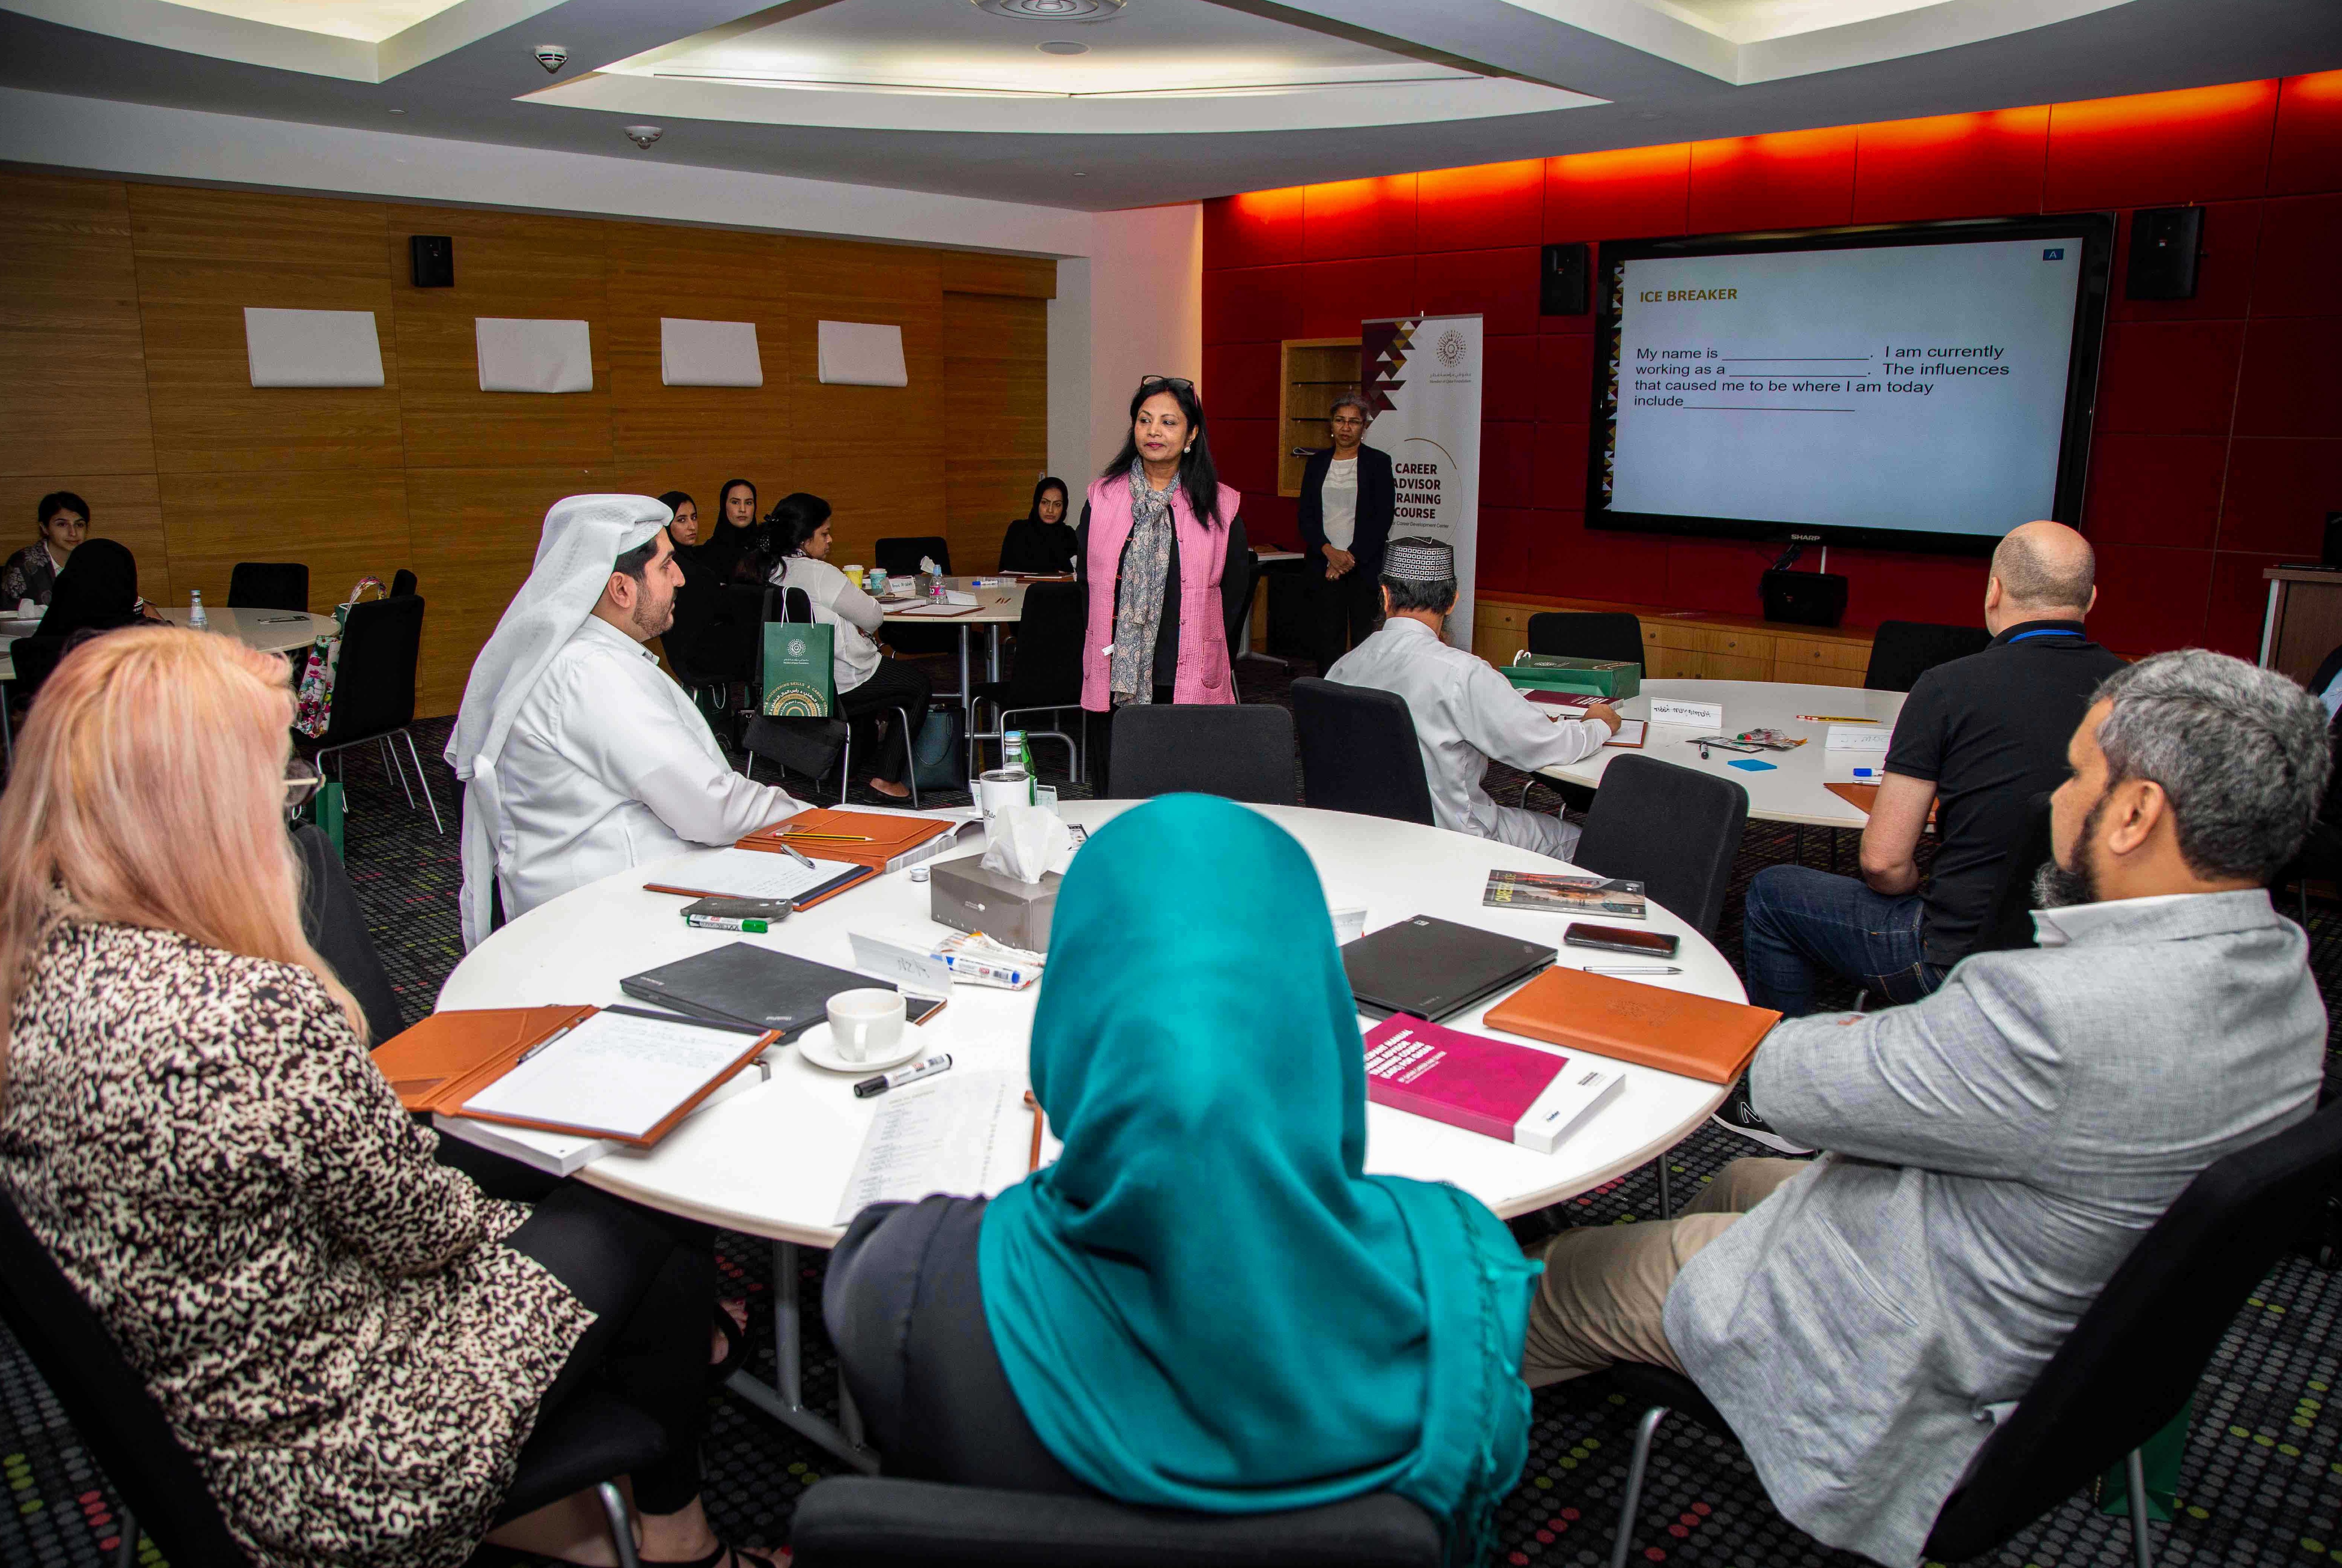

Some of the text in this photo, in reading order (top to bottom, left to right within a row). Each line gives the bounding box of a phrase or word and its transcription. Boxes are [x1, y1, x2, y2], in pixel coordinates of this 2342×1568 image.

[1639, 288, 1738, 303] ICE BREAKER
[1637, 348, 1718, 361] My name is
[1886, 345, 2004, 360] I am currently
[1636, 364, 1690, 377] working
[1716, 366, 1725, 375] a
[1883, 363, 2009, 375] The influences
[1635, 380, 1934, 395] that caused me to be where I am today
[1395, 463, 1437, 474] CAREER
[1393, 478, 1441, 490] ADVISOR
[1396, 493, 1441, 505] RAINING
[1394, 507, 1436, 519] COURSE
